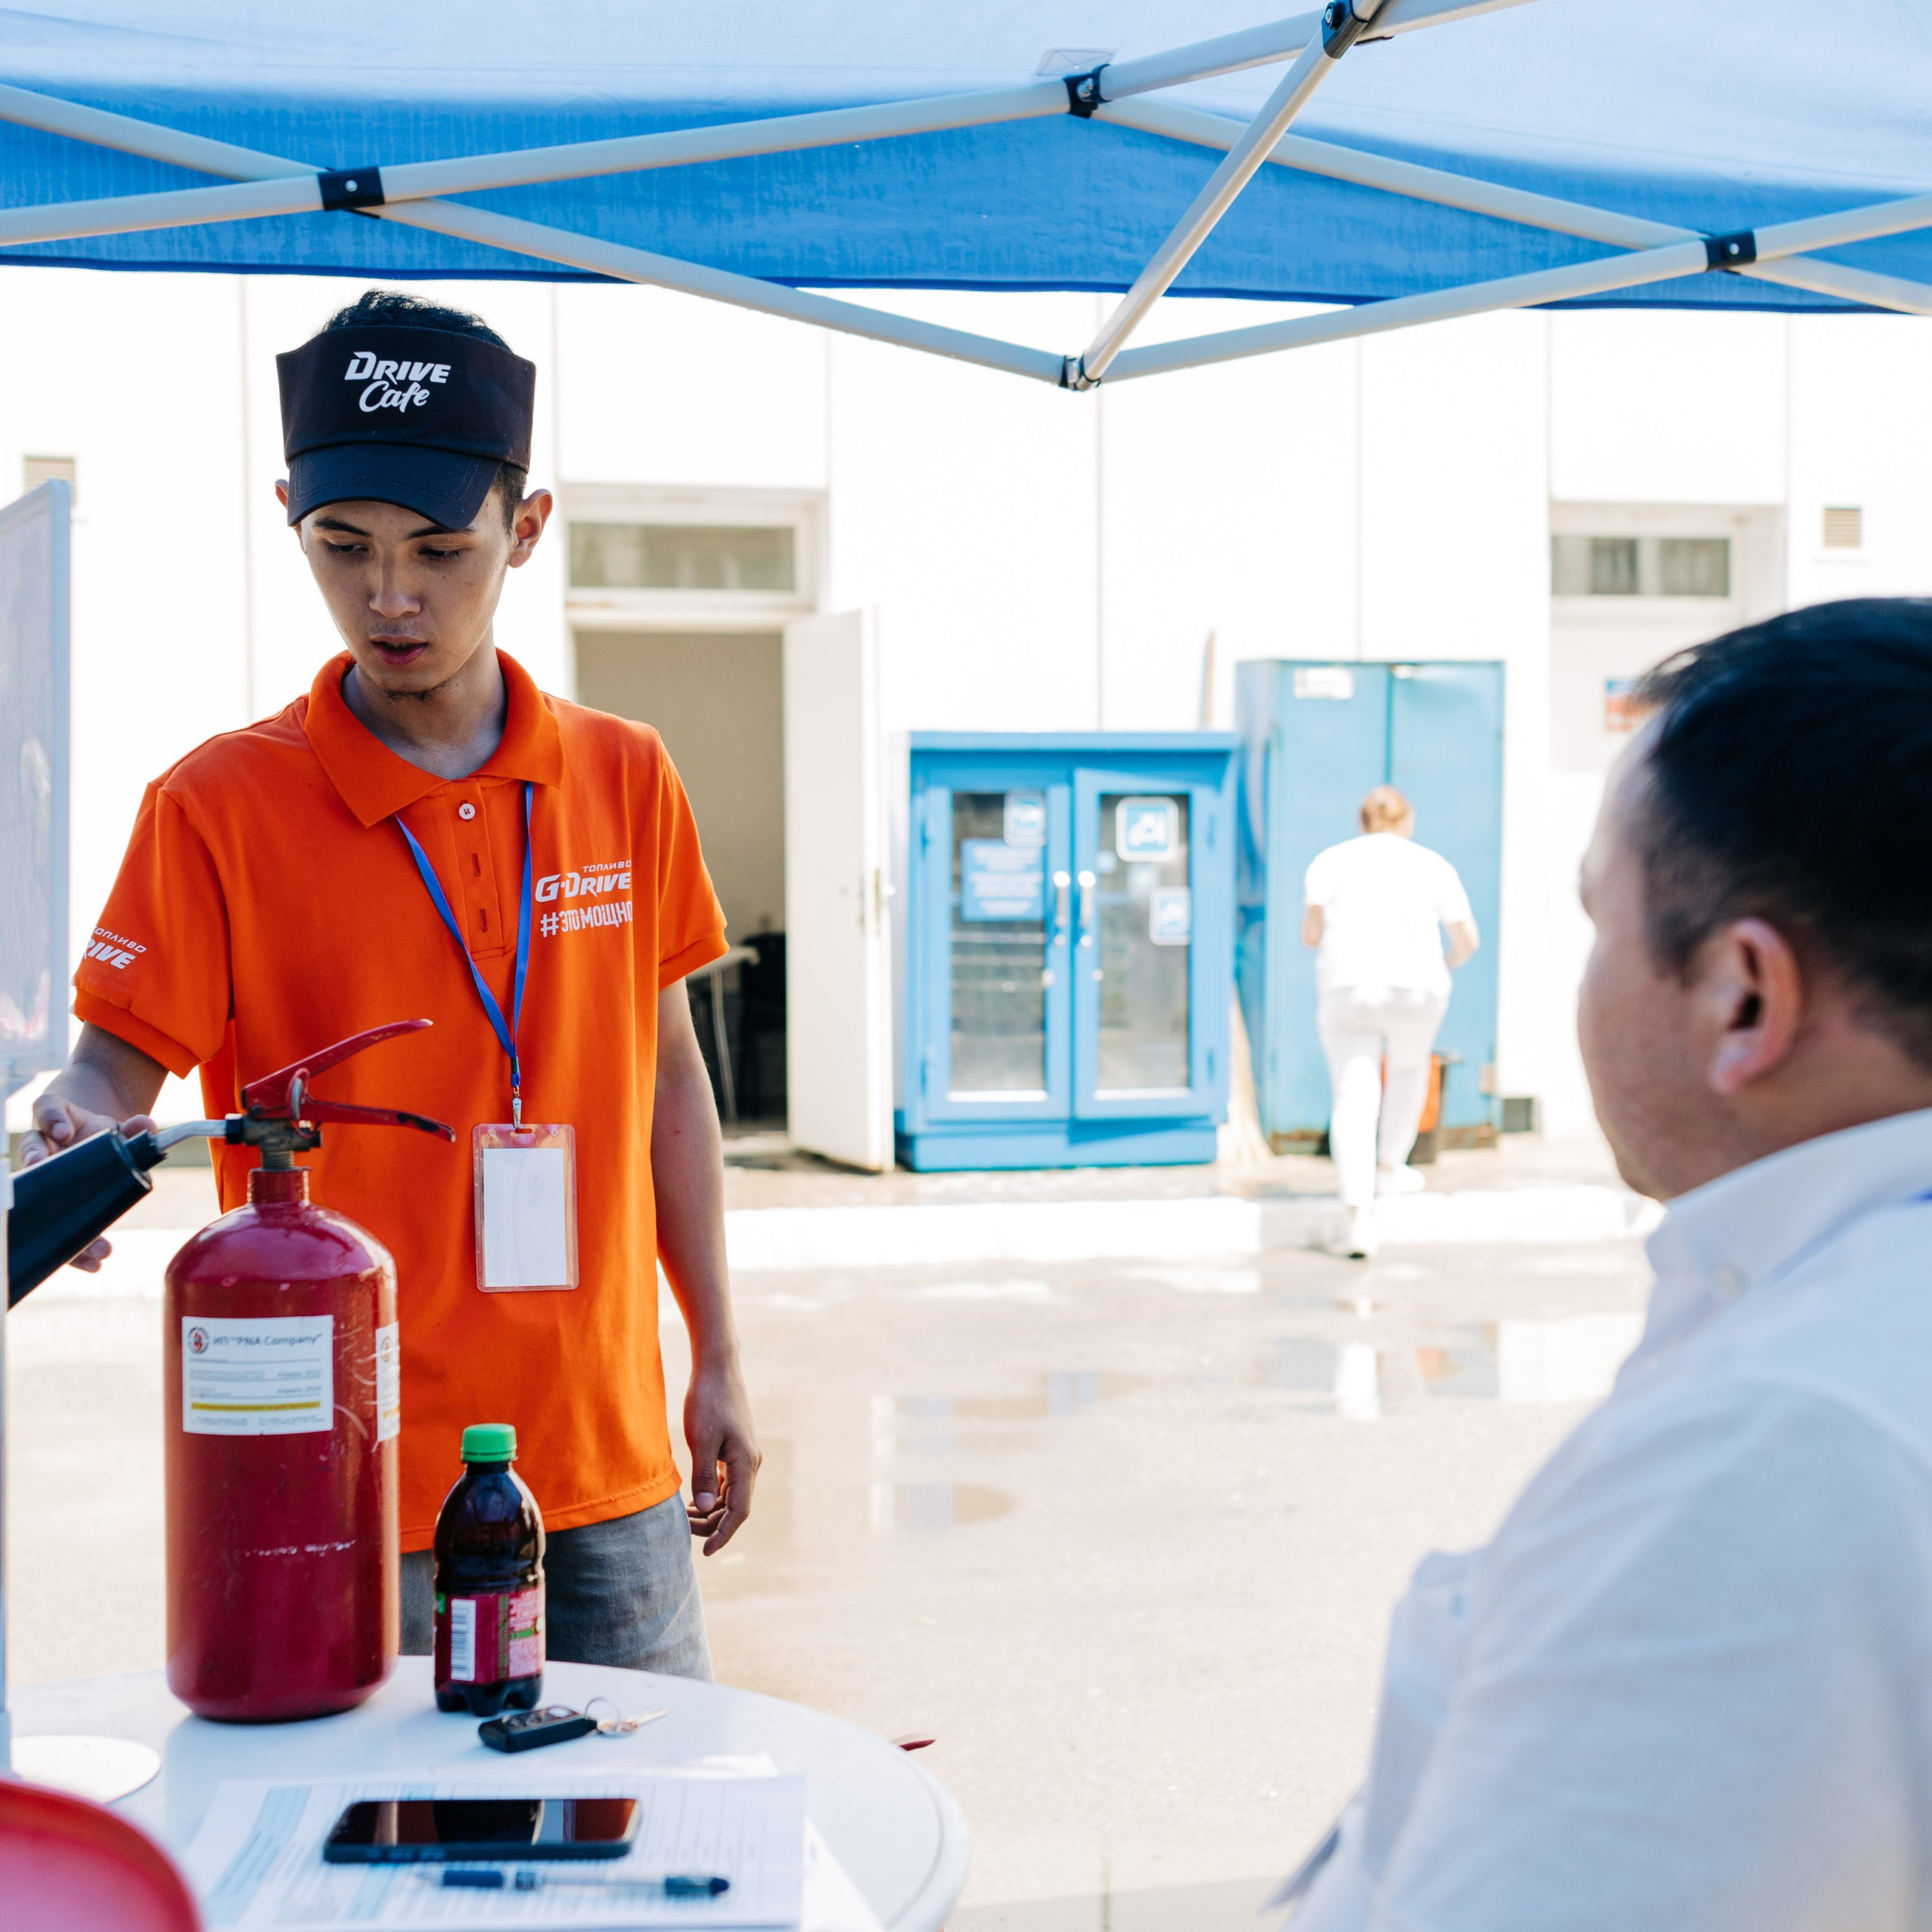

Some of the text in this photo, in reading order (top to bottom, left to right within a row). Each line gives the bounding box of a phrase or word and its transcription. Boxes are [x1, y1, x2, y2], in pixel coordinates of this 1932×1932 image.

[344, 351, 451, 385] DRIVE
[358, 380, 430, 413] Cafe
[583, 860, 632, 874] ТОПЛИВО
[94, 926, 147, 953] ОПЛИВО
